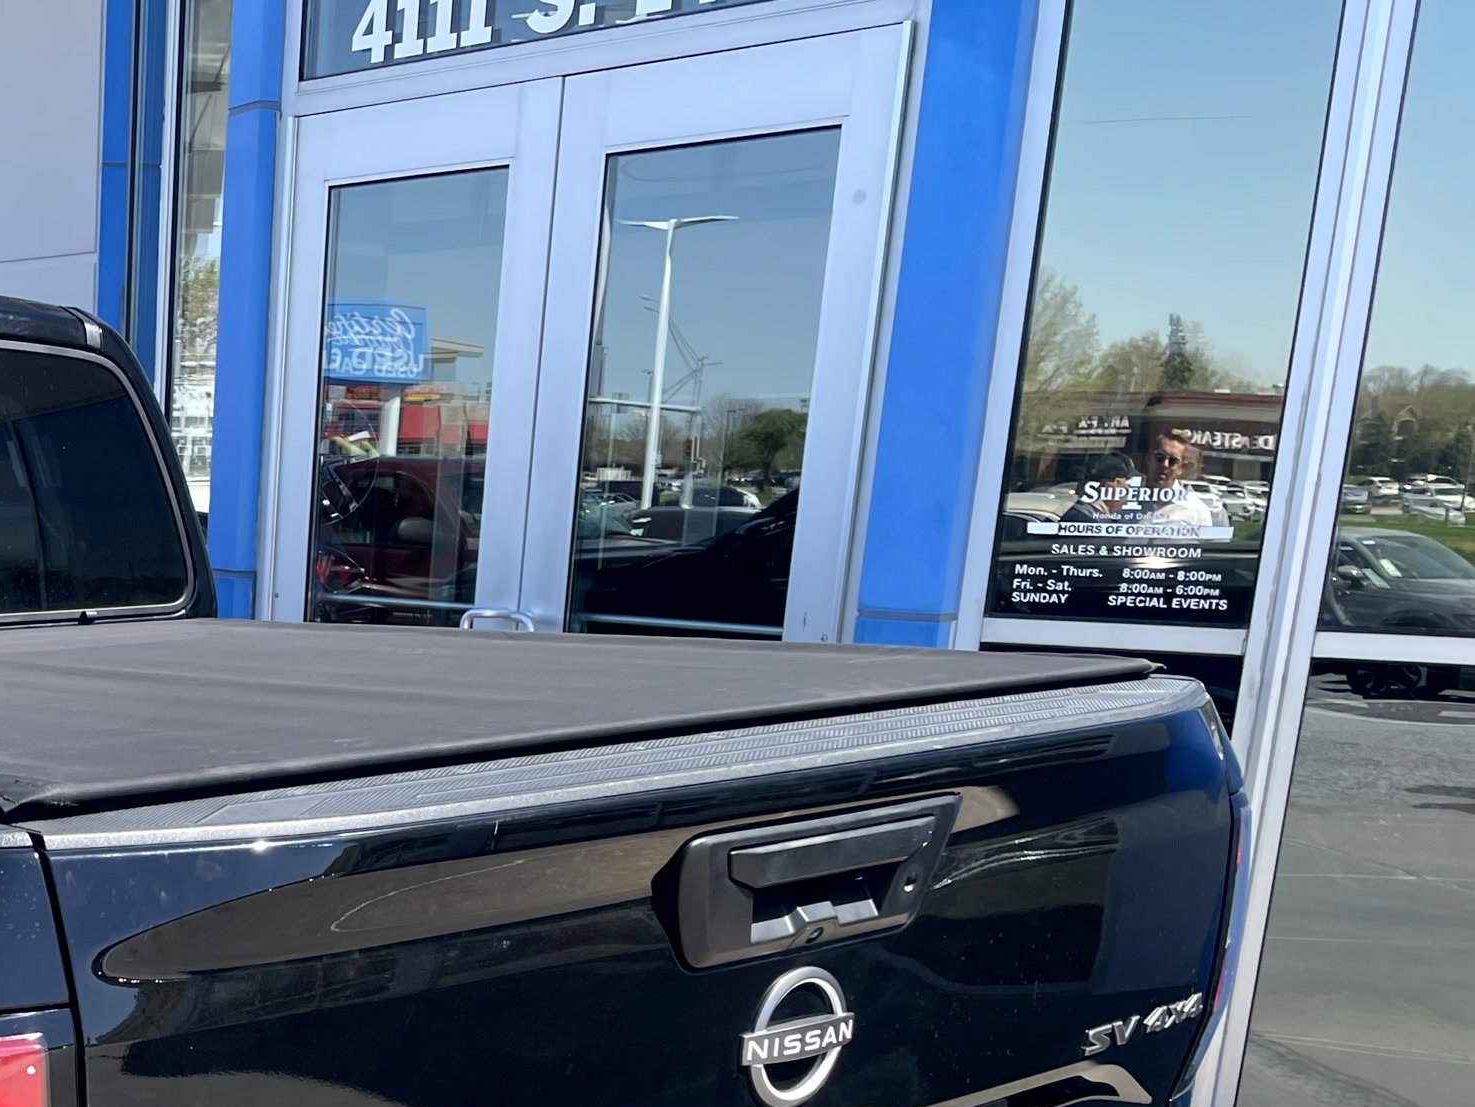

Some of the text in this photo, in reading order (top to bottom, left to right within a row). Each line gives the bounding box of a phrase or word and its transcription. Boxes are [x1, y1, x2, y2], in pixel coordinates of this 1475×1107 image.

[351, 0, 493, 63] 4111
[1081, 480, 1189, 504] SUPERIOR
[1058, 523, 1102, 534] HOURS
[1105, 525, 1124, 535] OF
[1051, 543, 1202, 559] SALES & SHOWROOM
[1014, 564, 1048, 576] Mon.
[1061, 565, 1104, 578] Thurs.
[1012, 578, 1034, 590] Fri.
[1046, 579, 1073, 592] Sat.
[1011, 591, 1228, 611] SUNDAY SPECIAL EVENTS
[746, 1018, 854, 1061] NISSAN
[1081, 1014, 1141, 1057] SV
